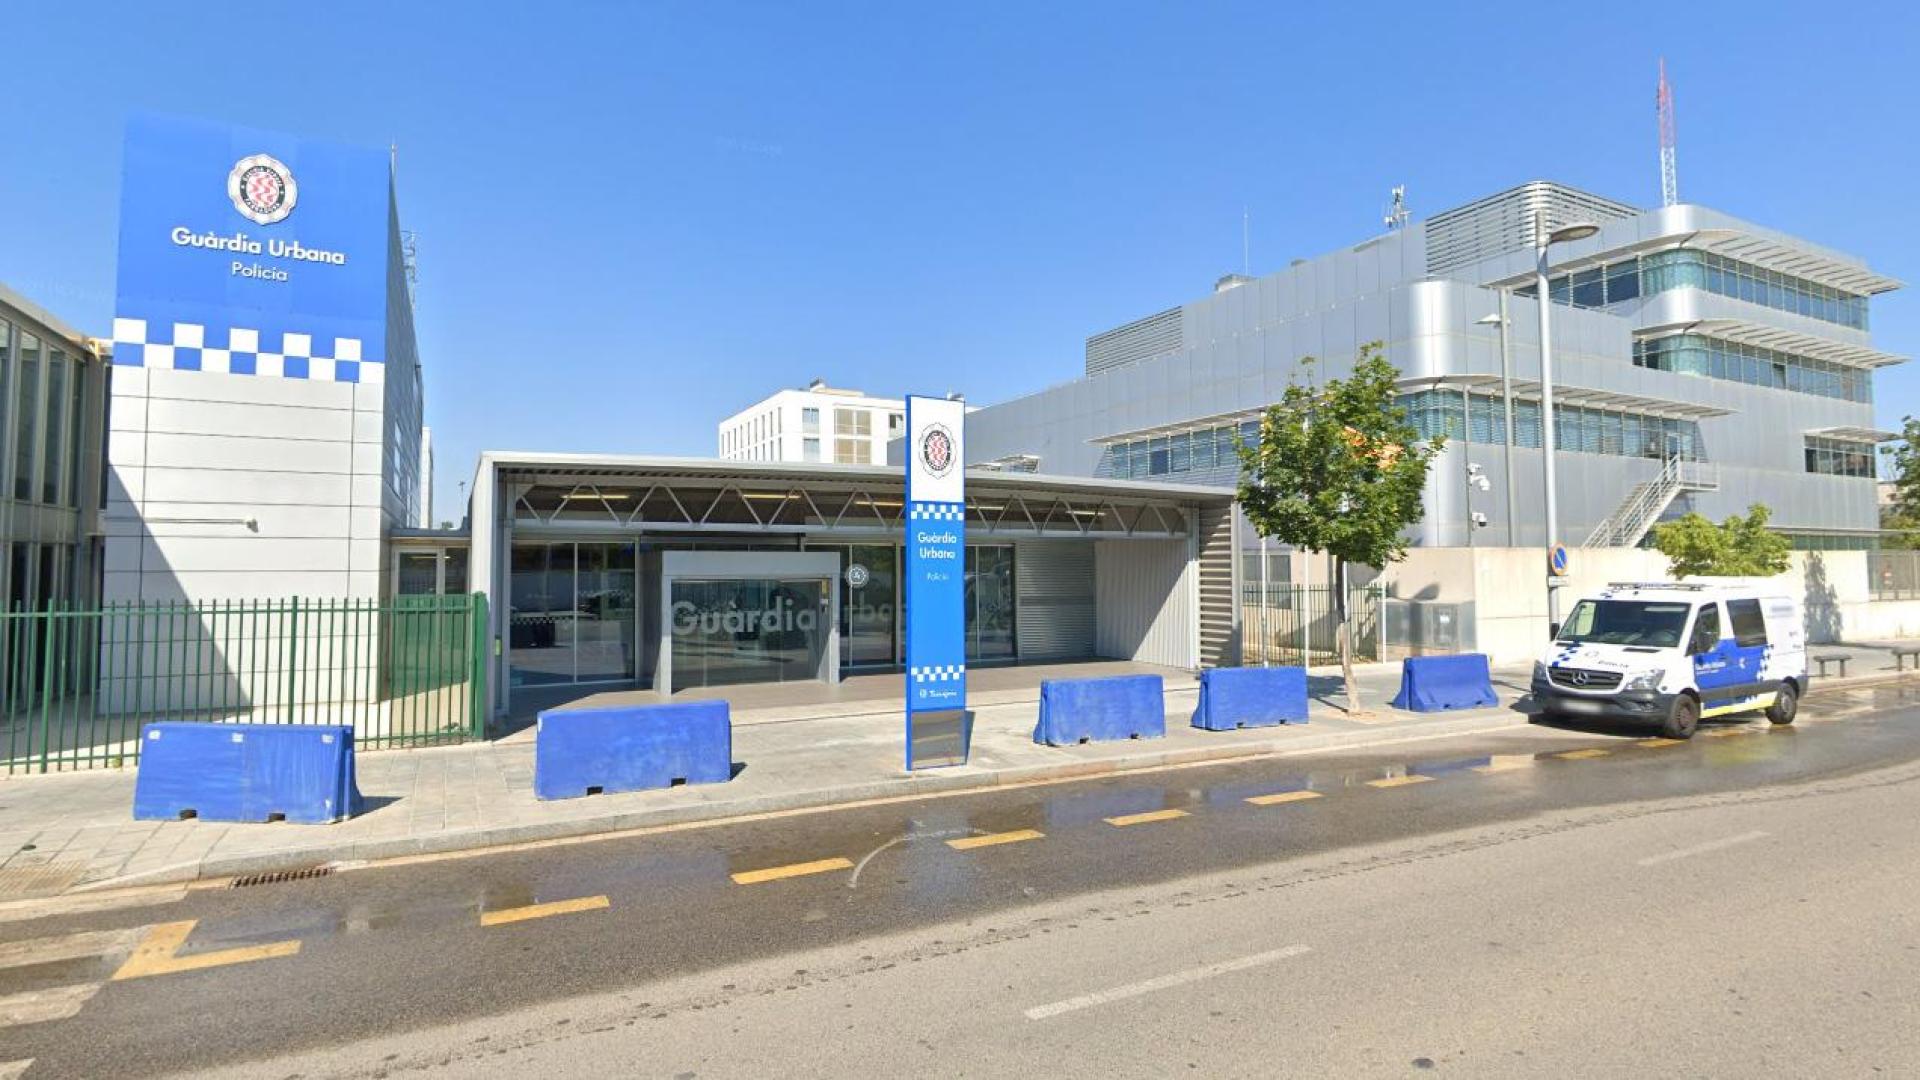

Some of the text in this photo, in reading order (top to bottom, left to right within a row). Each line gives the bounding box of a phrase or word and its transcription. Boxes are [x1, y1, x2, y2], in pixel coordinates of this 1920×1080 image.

[171, 226, 346, 265] Guàrdia Urbana
[231, 261, 288, 282] Policia
[917, 531, 957, 544] Guàrdia
[919, 546, 956, 559] Urbana
[672, 595, 817, 635] Guàrdia
